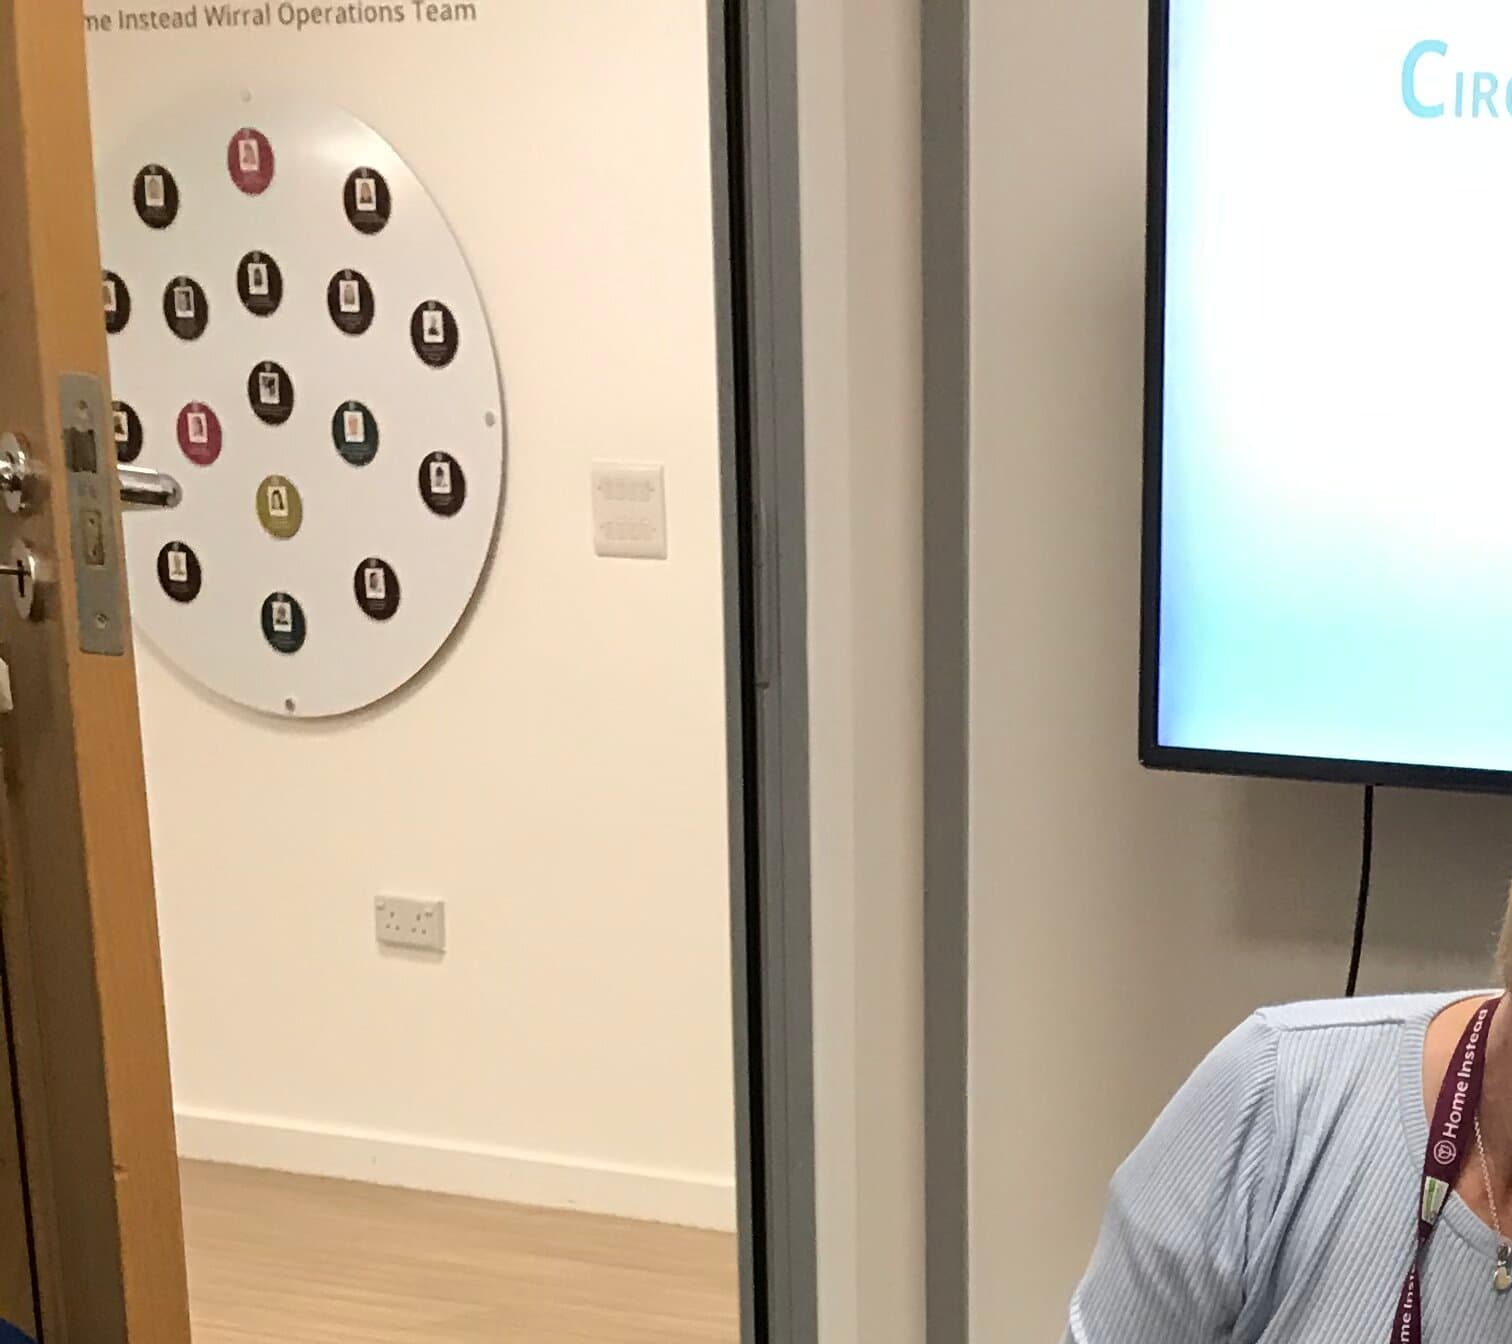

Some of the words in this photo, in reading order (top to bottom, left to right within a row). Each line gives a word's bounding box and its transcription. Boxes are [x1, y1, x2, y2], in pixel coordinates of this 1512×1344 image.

[85, 14, 112, 32] me
[118, 5, 198, 30] Instead
[204, 3, 271, 27] Wirral
[277, 2, 405, 32] Operations
[411, 0, 477, 22] Team
[1442, 1081, 1469, 1139] Home
